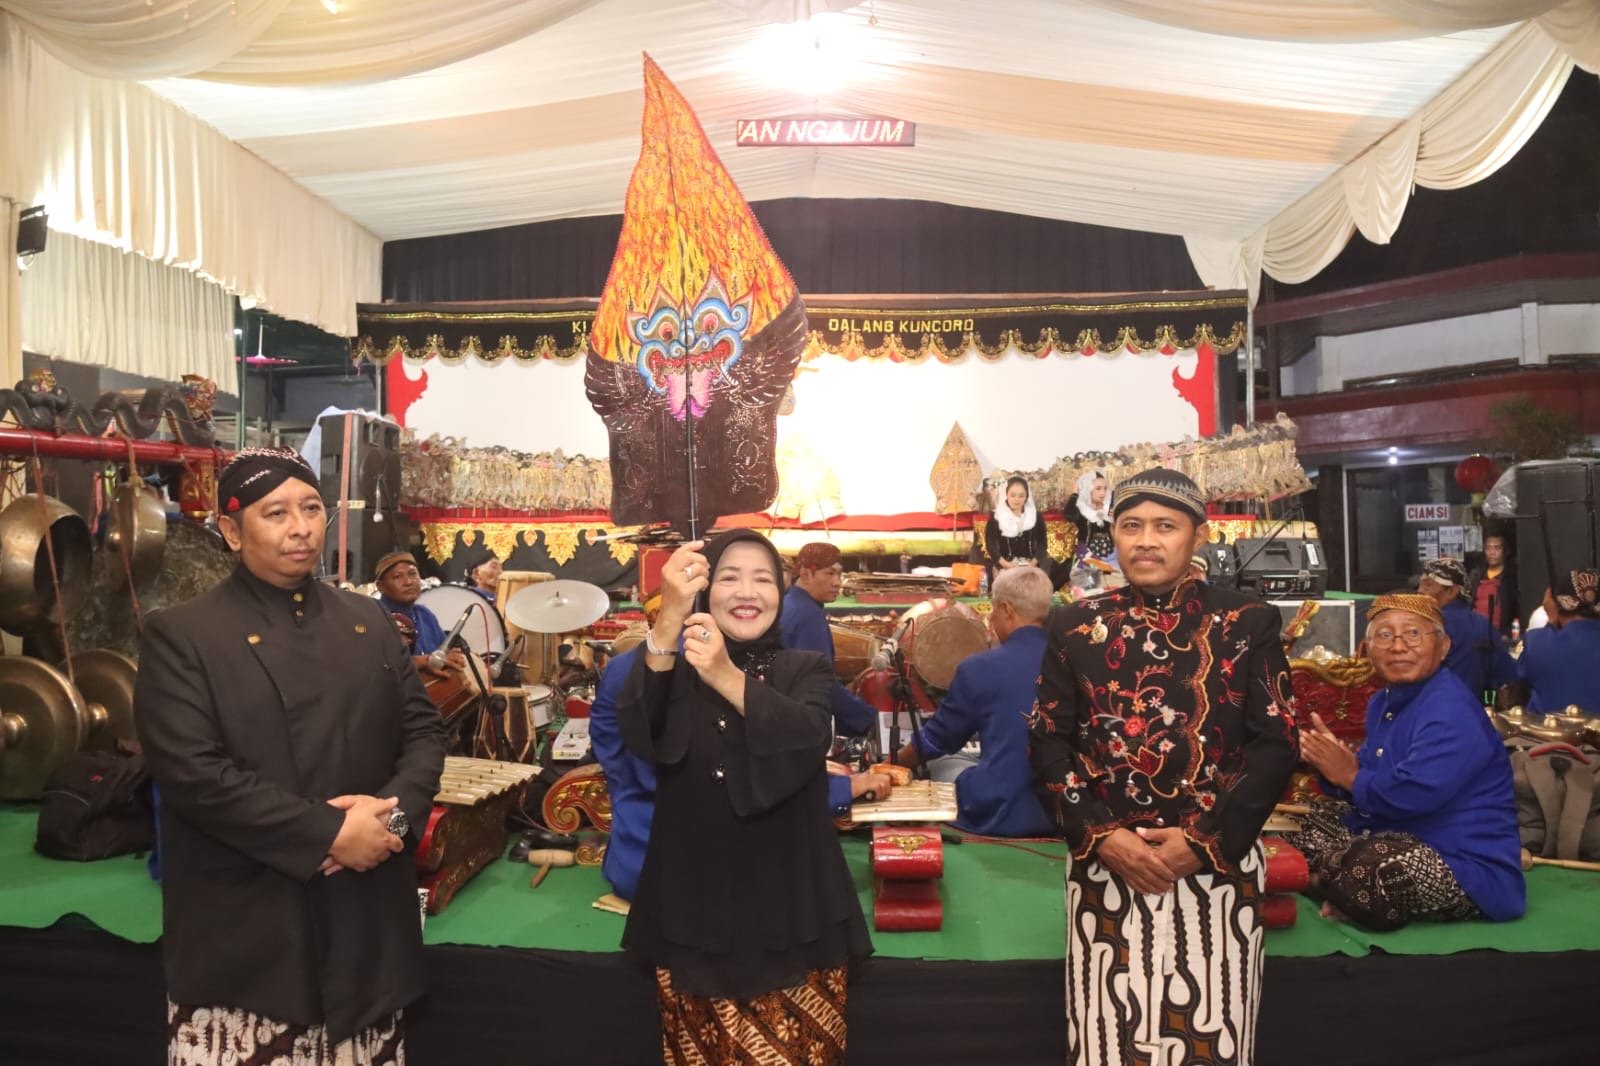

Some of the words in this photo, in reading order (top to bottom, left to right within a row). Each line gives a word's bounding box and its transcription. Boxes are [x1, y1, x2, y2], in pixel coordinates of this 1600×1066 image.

[786, 120, 905, 143] NGAJUM
[828, 318, 894, 333] DALANG
[899, 318, 974, 333] KUNCORO
